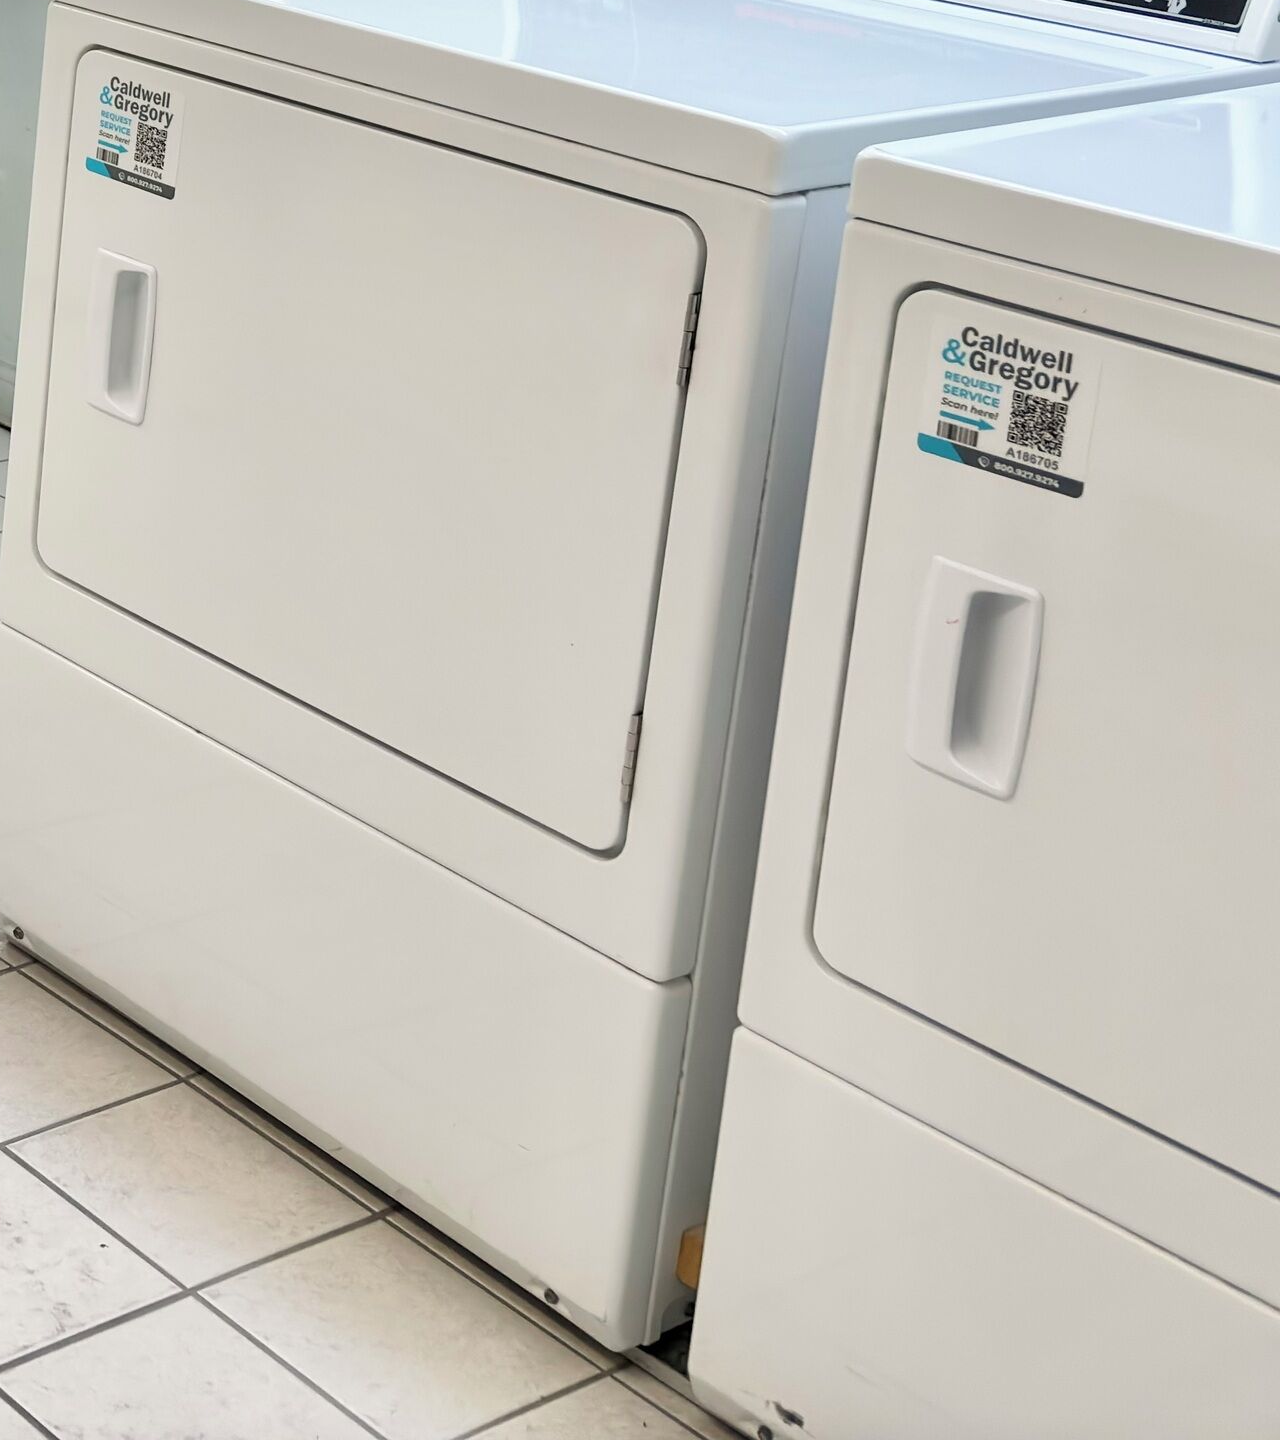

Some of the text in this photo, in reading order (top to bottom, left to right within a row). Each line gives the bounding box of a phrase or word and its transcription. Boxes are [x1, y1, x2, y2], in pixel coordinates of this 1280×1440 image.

[110, 76, 170, 108] Caldwell
[100, 120, 131, 136] SERVICE
[101, 110, 132, 126] REQUEST
[99, 129, 130, 145] Scan here!
[962, 326, 1073, 373] Caldwell
[945, 371, 1002, 394] REQUEST
[943, 384, 1000, 408] SERVICE
[941, 397, 999, 420] Scan here!
[1006, 447, 1059, 470] A186705
